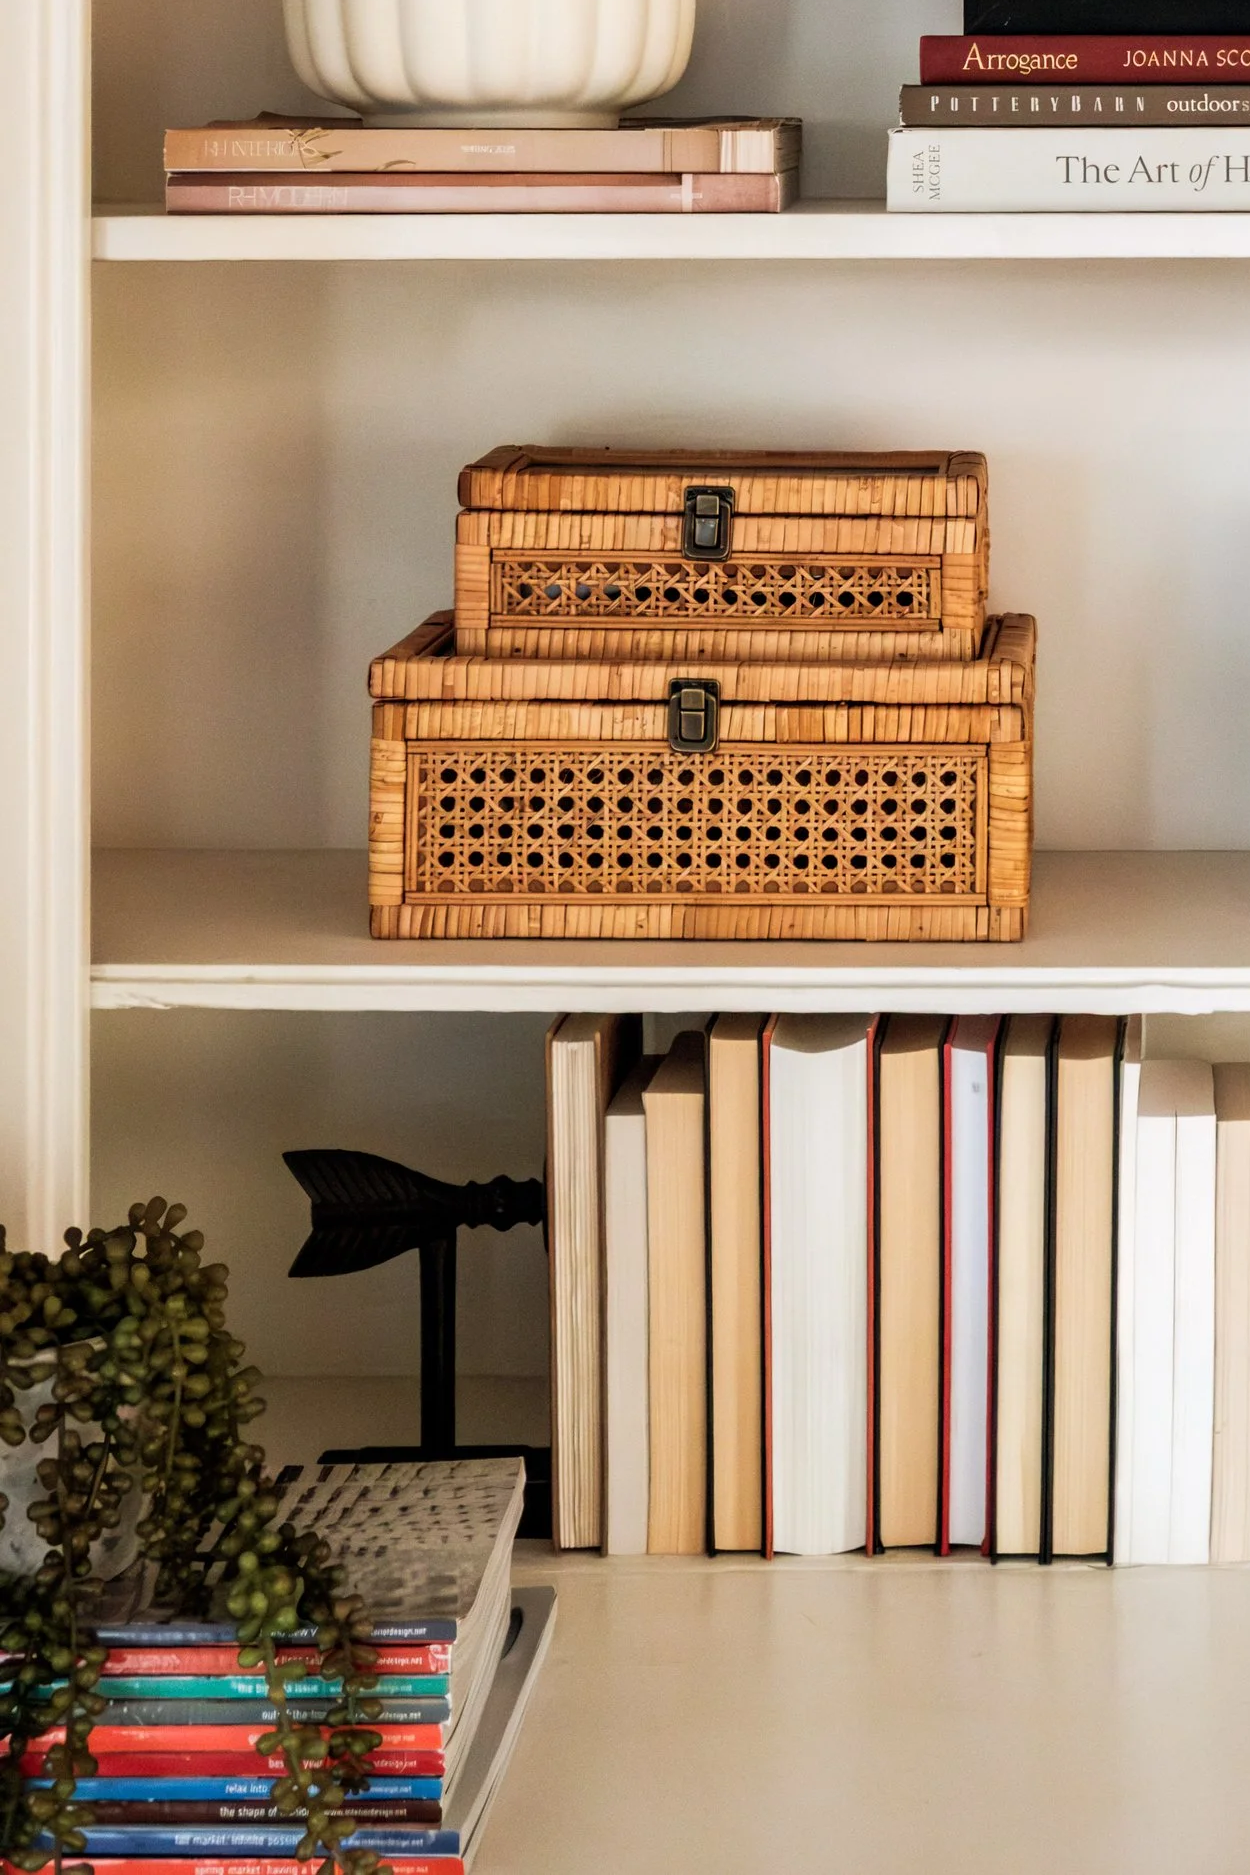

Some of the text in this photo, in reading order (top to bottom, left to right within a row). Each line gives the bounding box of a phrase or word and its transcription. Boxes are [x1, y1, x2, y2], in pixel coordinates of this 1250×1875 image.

[962, 42, 1078, 75] Arrogance
[1123, 50, 1209, 67] JOANNA
[912, 150, 924, 194] SHEA
[929, 143, 941, 201] MCGEE
[1056, 155, 1120, 184] The
[1128, 156, 1177, 184] Art
[1188, 155, 1219, 192] of
[268, 1758, 284, 1769] bes
[220, 1806, 235, 1817] the
[238, 1806, 265, 1818] shape
[268, 1806, 278, 1817] of
